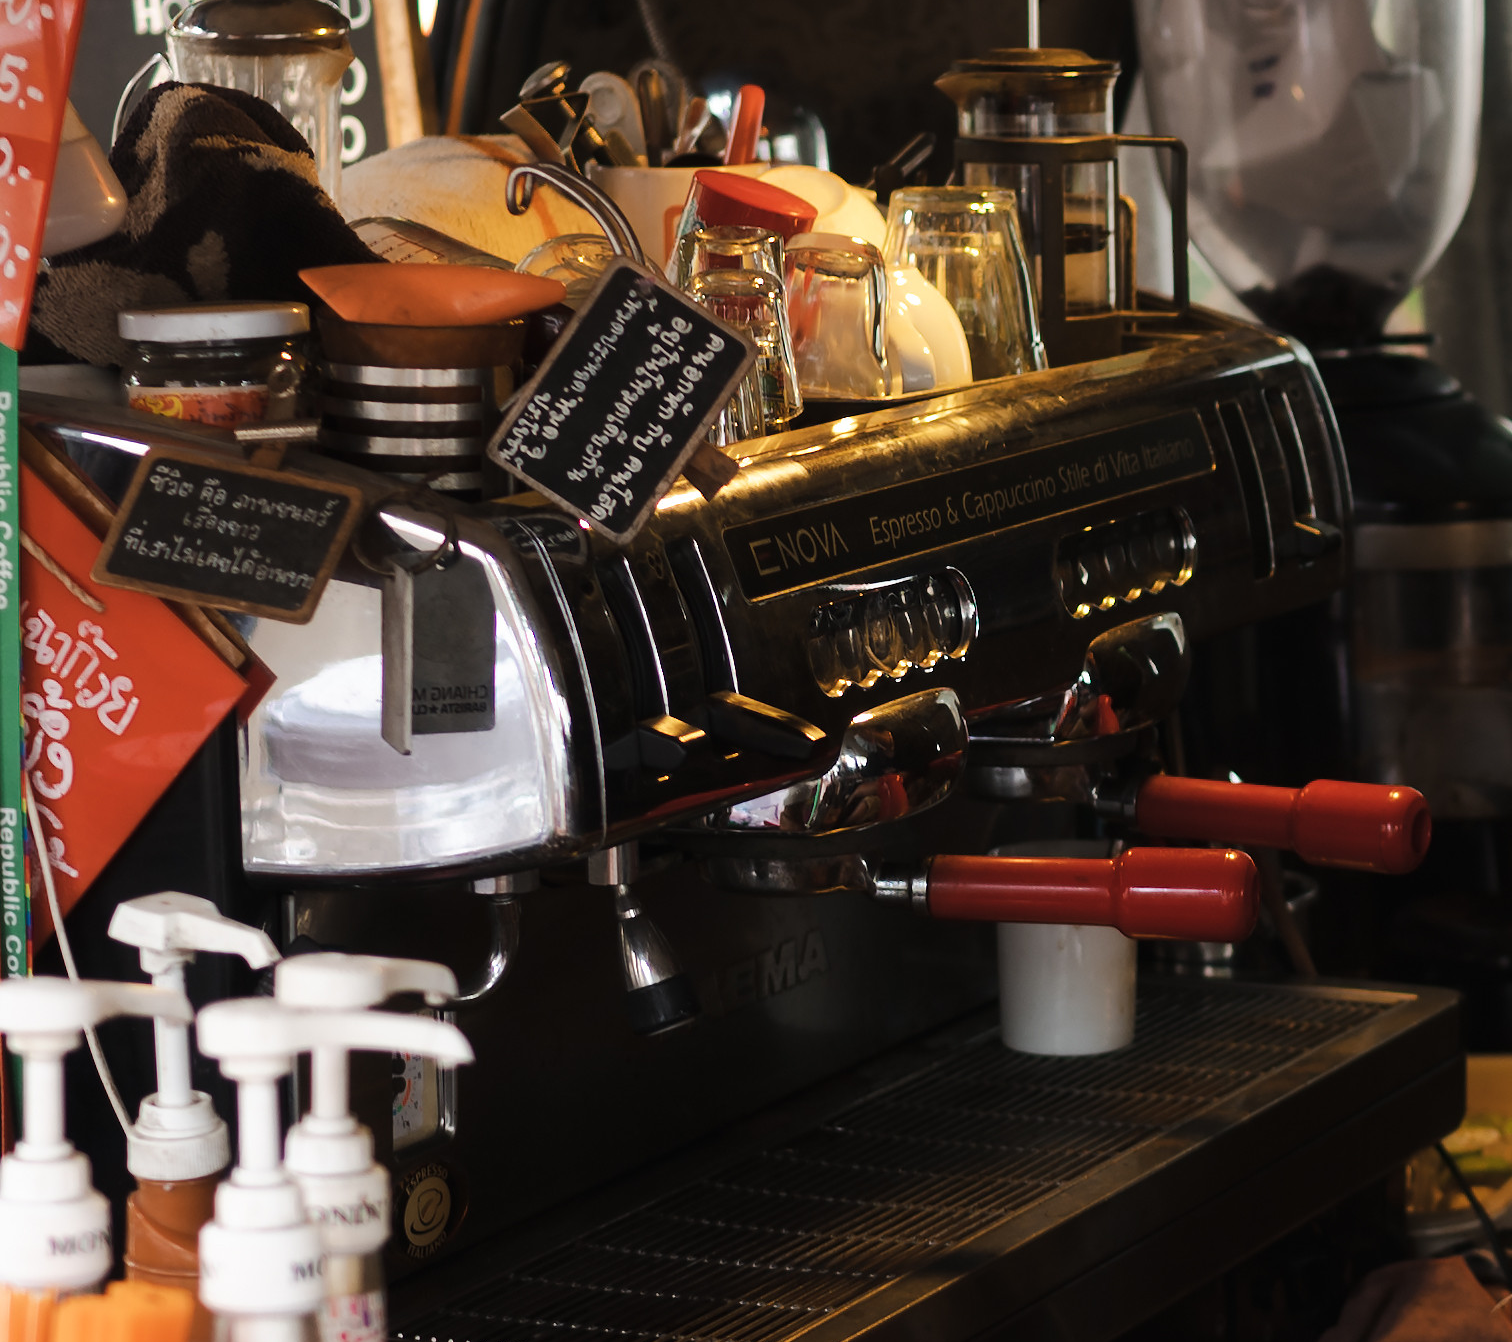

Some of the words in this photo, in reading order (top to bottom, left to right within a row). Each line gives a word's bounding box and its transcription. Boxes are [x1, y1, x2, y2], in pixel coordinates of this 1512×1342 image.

[869, 505, 942, 549] Espresso
[947, 497, 960, 522] &
[962, 475, 1056, 524] Cappuccino
[1058, 463, 1092, 493] Stile
[1095, 455, 1109, 484] di
[1110, 448, 1141, 480] Vita
[405, 1163, 449, 1196] ESPRESSO
[406, 1229, 448, 1260] ITALIANO
